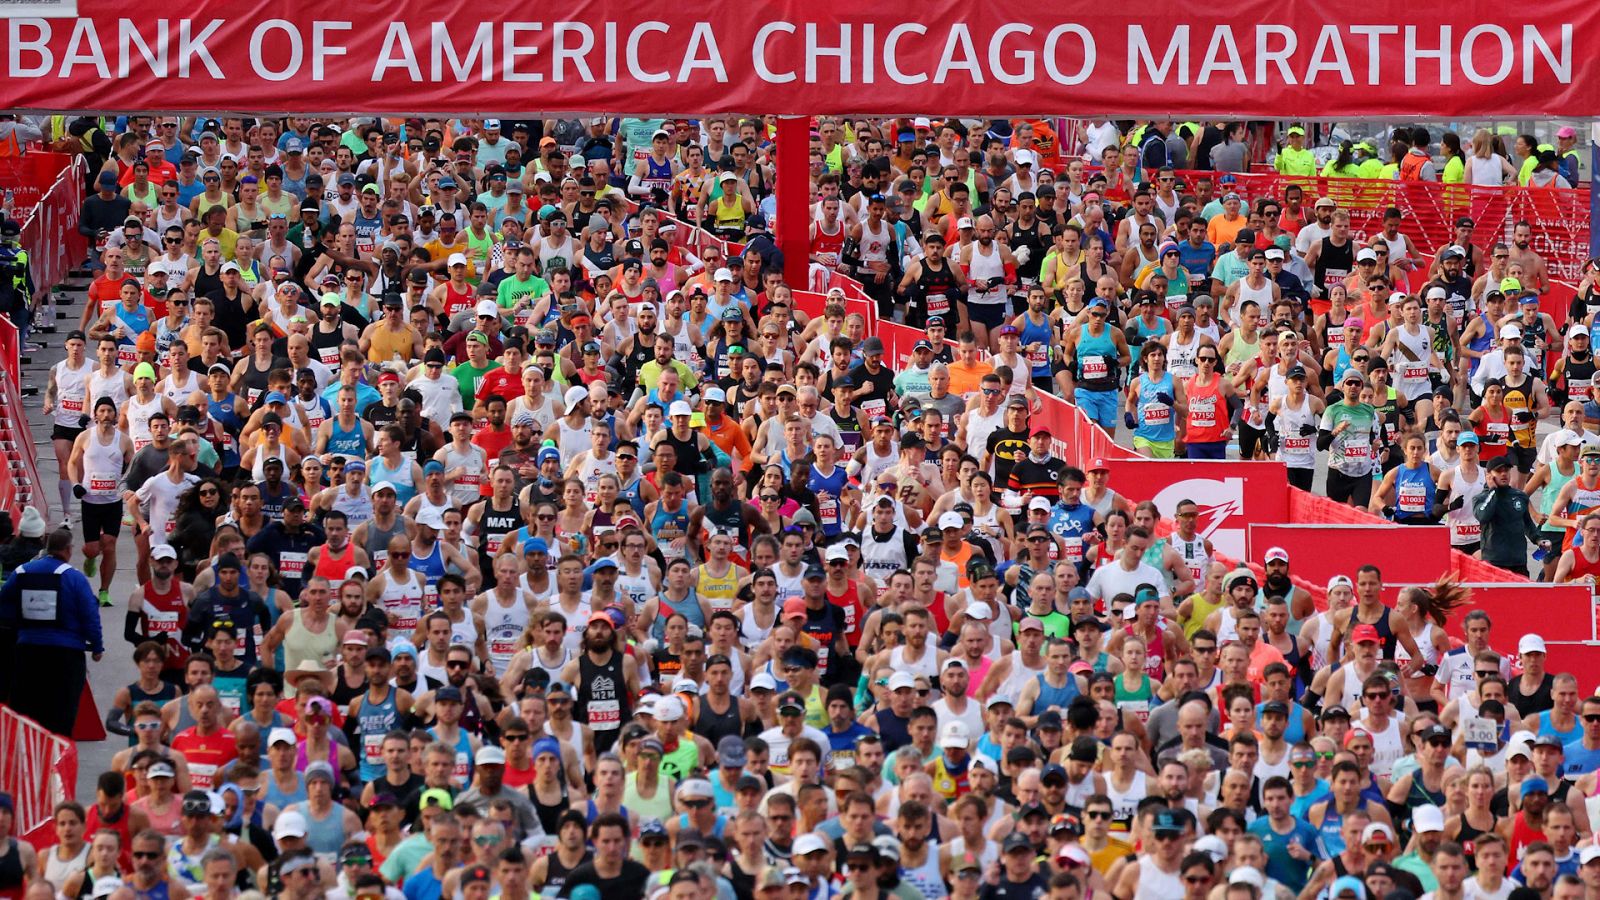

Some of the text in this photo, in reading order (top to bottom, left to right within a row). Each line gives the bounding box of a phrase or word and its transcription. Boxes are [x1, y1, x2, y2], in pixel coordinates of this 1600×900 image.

[8, 17, 1573, 85] BANK OF AMERICA CHICAGO MARATHON
[1348, 210, 1383, 218] MERIC
[1535, 235, 1589, 258] Chicag
[486, 517, 515, 528] MAT
[592, 690, 616, 699] M2M
[360, 715, 385, 723] FLEET
[589, 713, 596, 721] A
